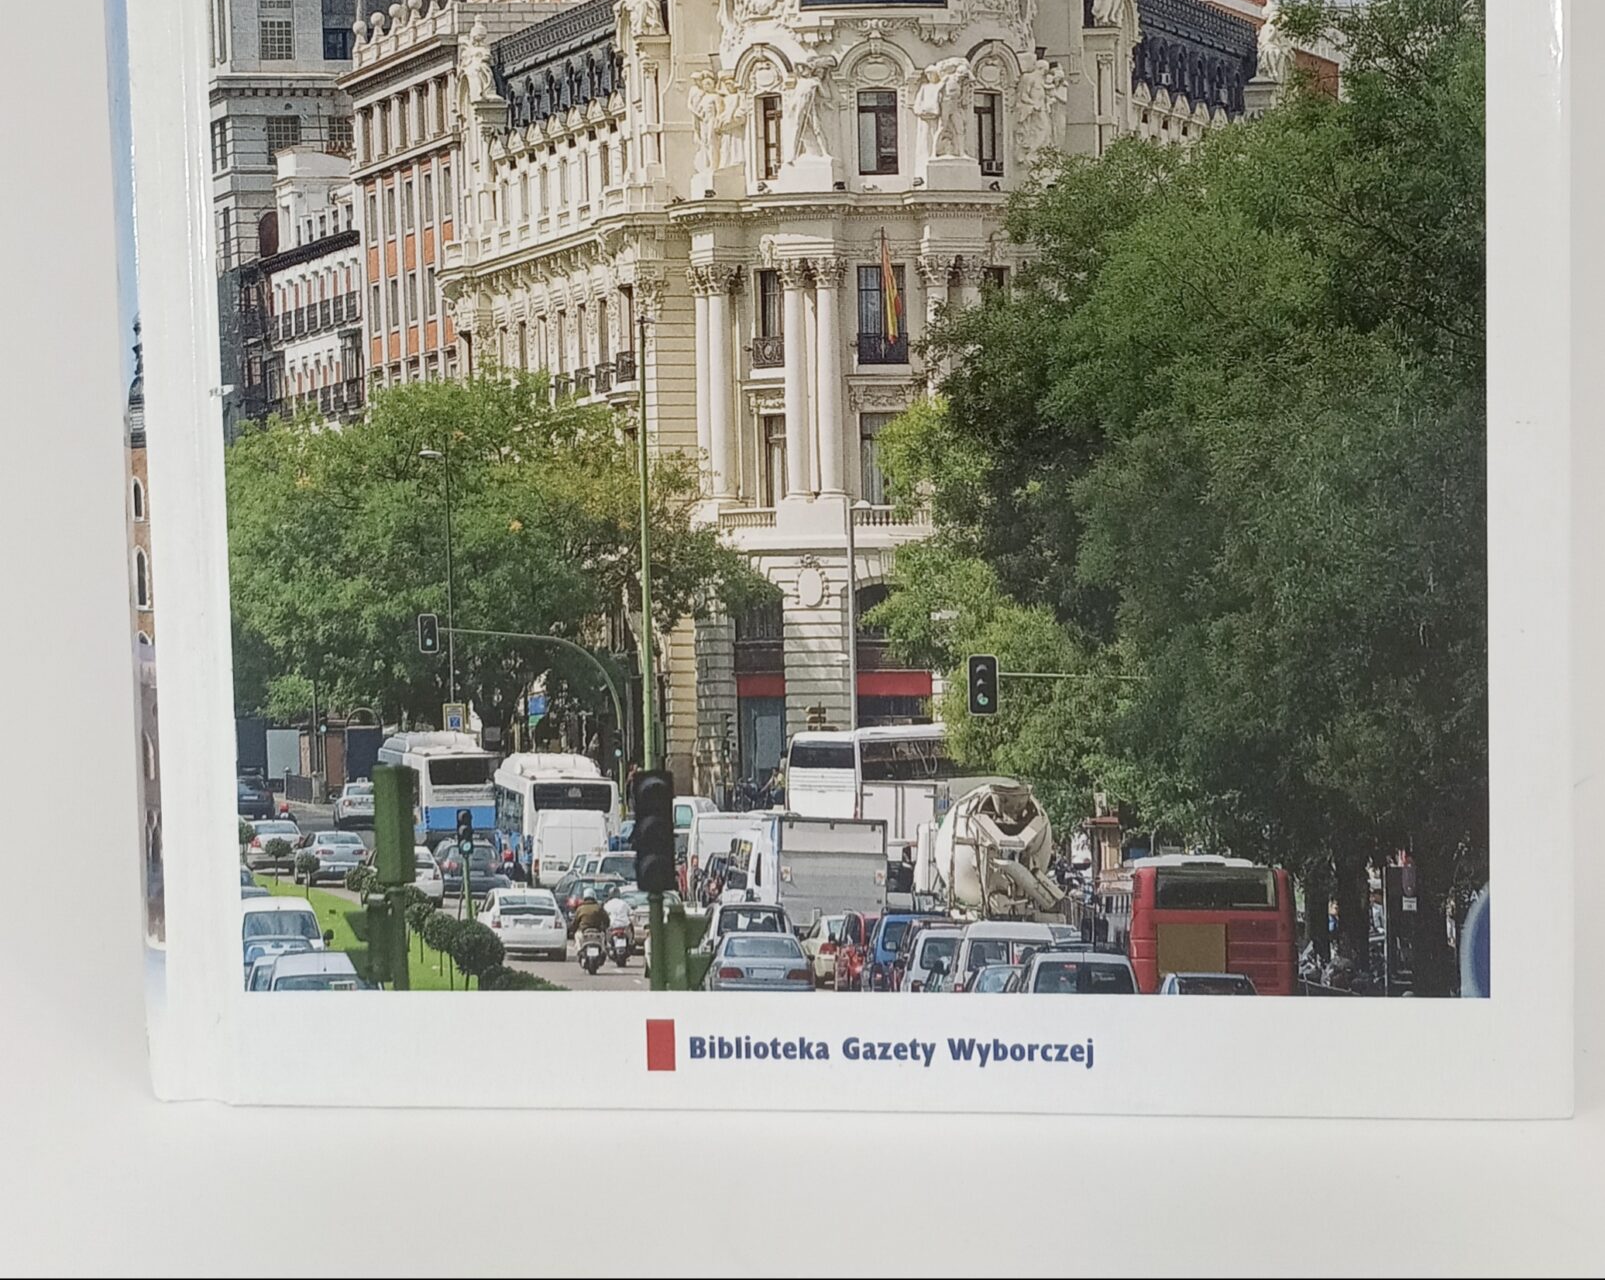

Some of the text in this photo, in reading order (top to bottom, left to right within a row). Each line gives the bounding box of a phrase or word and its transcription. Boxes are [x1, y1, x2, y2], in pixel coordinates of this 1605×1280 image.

[688, 1035, 1095, 1070] Biblioteka Gazety Wyborczej
